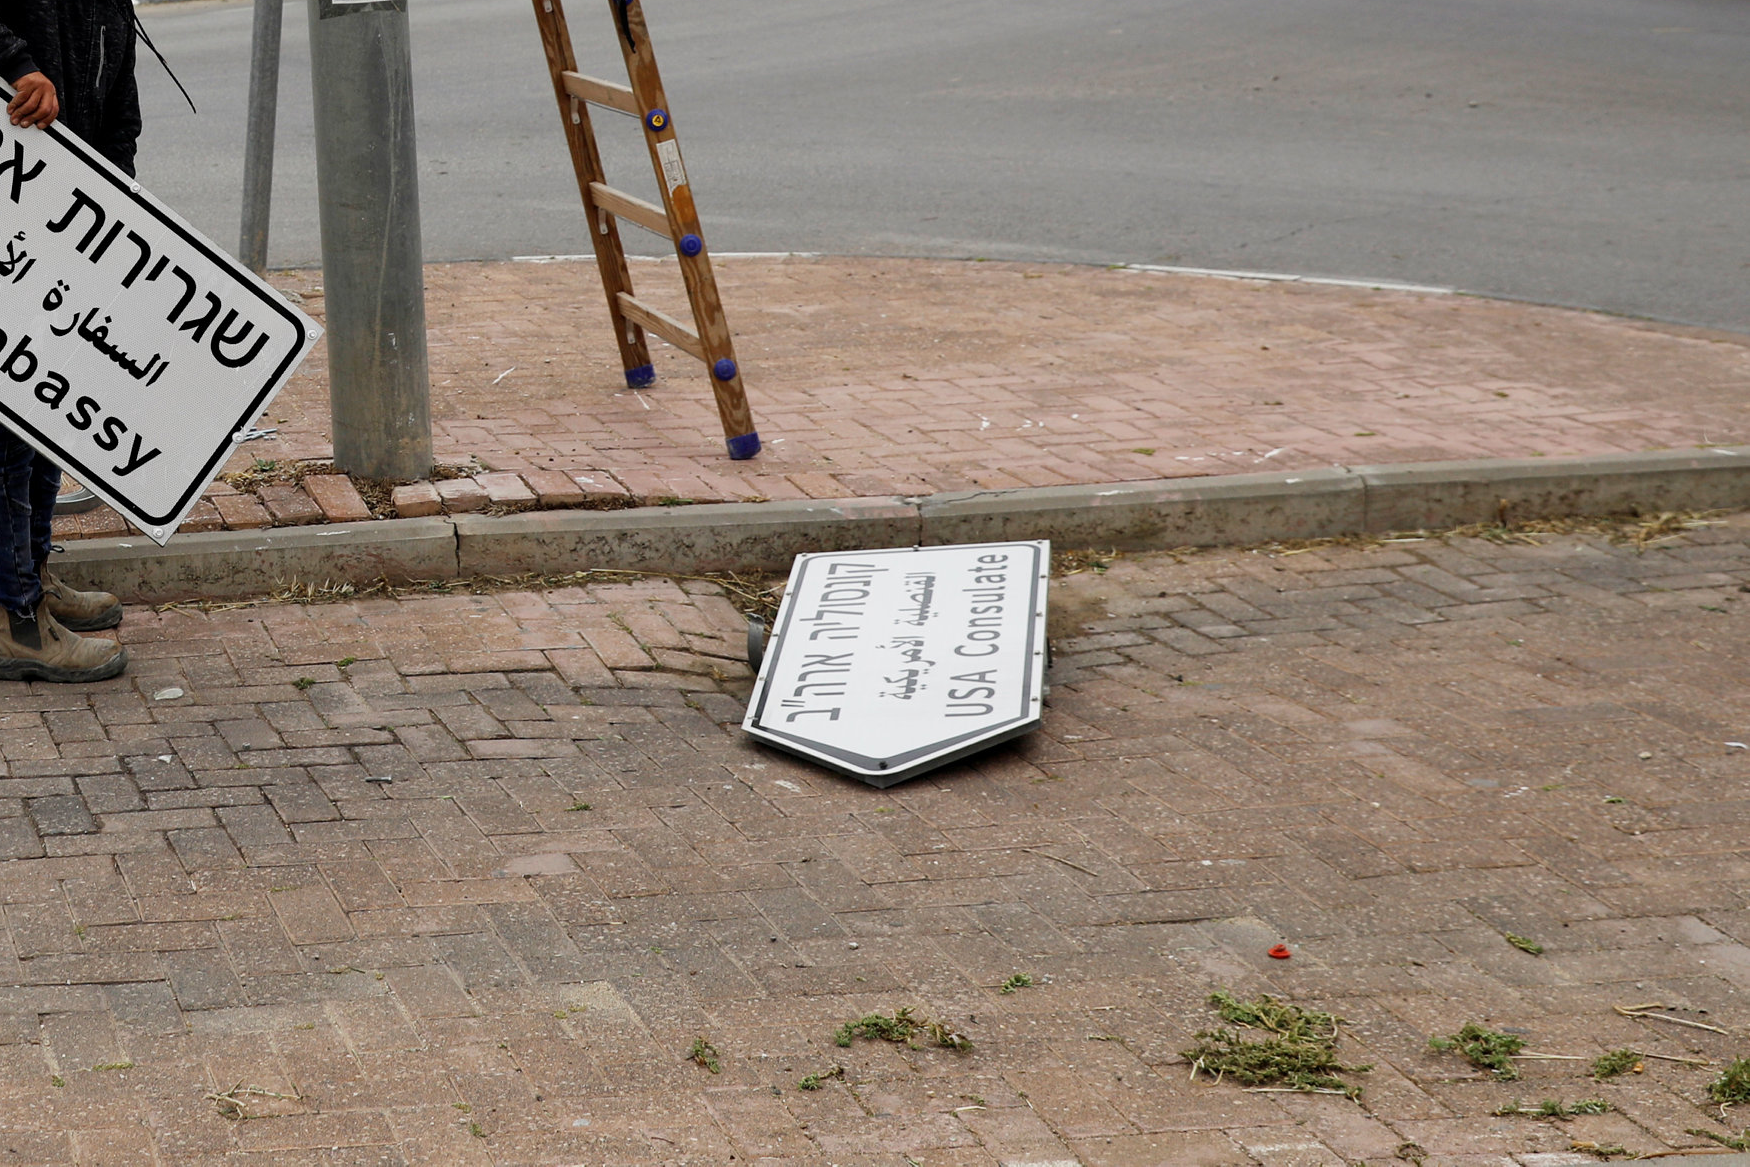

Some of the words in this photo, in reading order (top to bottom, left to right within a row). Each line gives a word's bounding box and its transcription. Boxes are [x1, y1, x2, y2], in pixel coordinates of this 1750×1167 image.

[46, 188, 270, 368] שגרירות
[42, 279, 170, 387] السفارة
[799, 562, 889, 641] קונסוליה
[893, 572, 939, 626] القنصلية
[953, 553, 1009, 657] Consulate
[780, 653, 854, 722] ארה"ב
[875, 636, 936, 700] الأمريكية
[944, 669, 998, 718] USA
